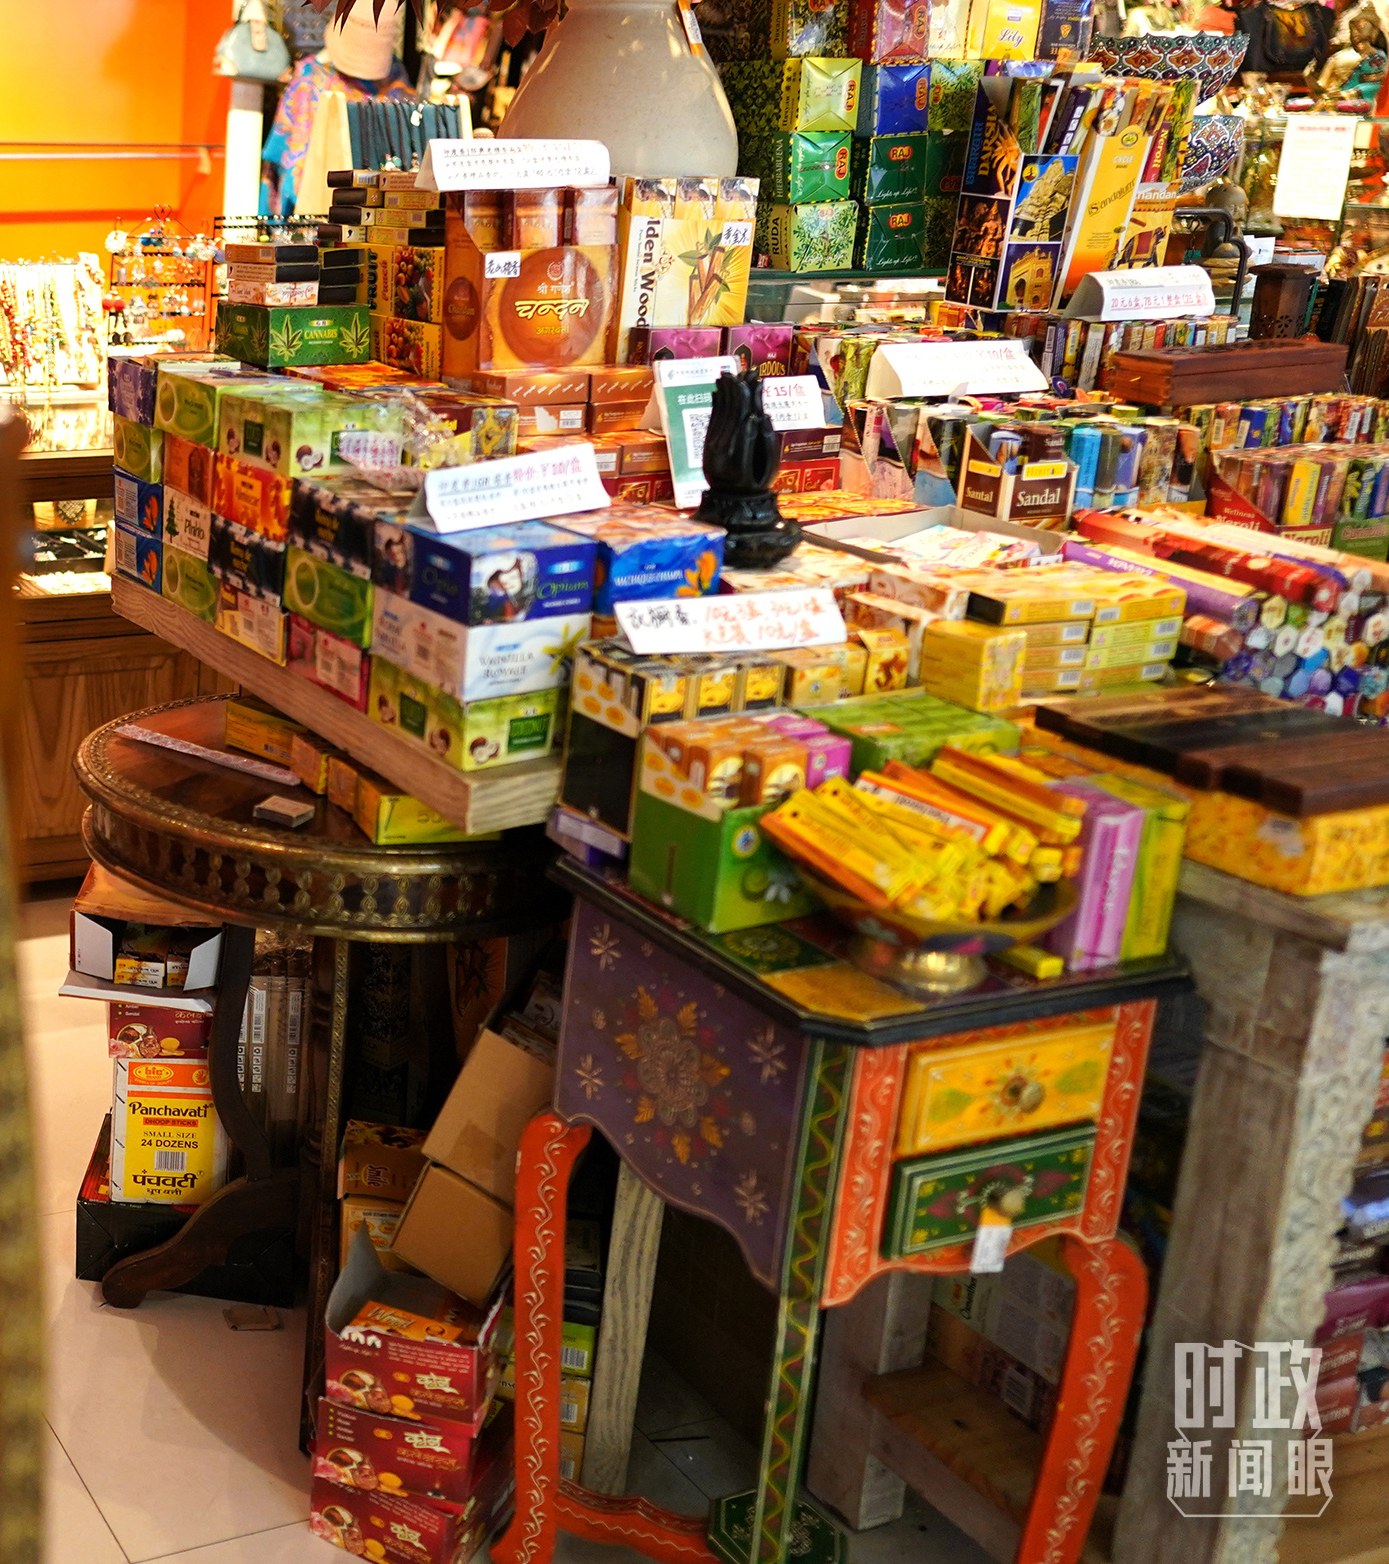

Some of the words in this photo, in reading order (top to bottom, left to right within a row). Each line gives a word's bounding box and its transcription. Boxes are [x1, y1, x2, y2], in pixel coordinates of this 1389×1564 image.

[916, 10, 926, 36] RAJ
[998, 28, 1024, 48] Lily
[846, 83, 856, 108] RAJ
[917, 82, 926, 108] RAJ
[891, 148, 910, 160] RAJ
[1152, 128, 1169, 168] Neroli
[776, 138, 784, 198] HIERBABUENA
[838, 150, 847, 176] RAJ
[1113, 156, 1134, 164] CYCLE
[890, 215, 910, 227] RAJ
[771, 216, 780, 256] RUDA
[367, 248, 379, 311] FRUIT
[636, 270, 656, 327] Wood
[515, 298, 590, 320] चन्दन
[304, 328, 339, 340] CANNABIS
[965, 486, 994, 503] Santal
[1016, 487, 1061, 507] Sandal
[1224, 507, 1255, 519] Wellness
[536, 580, 589, 600] Opium
[129, 1101, 208, 1118] Panchavati
[172, 1119, 197, 1127] STICKS
[141, 1139, 153, 1147] 24
[155, 1139, 199, 1149] DOZENS
[132, 1168, 198, 1189] पंचवटी
